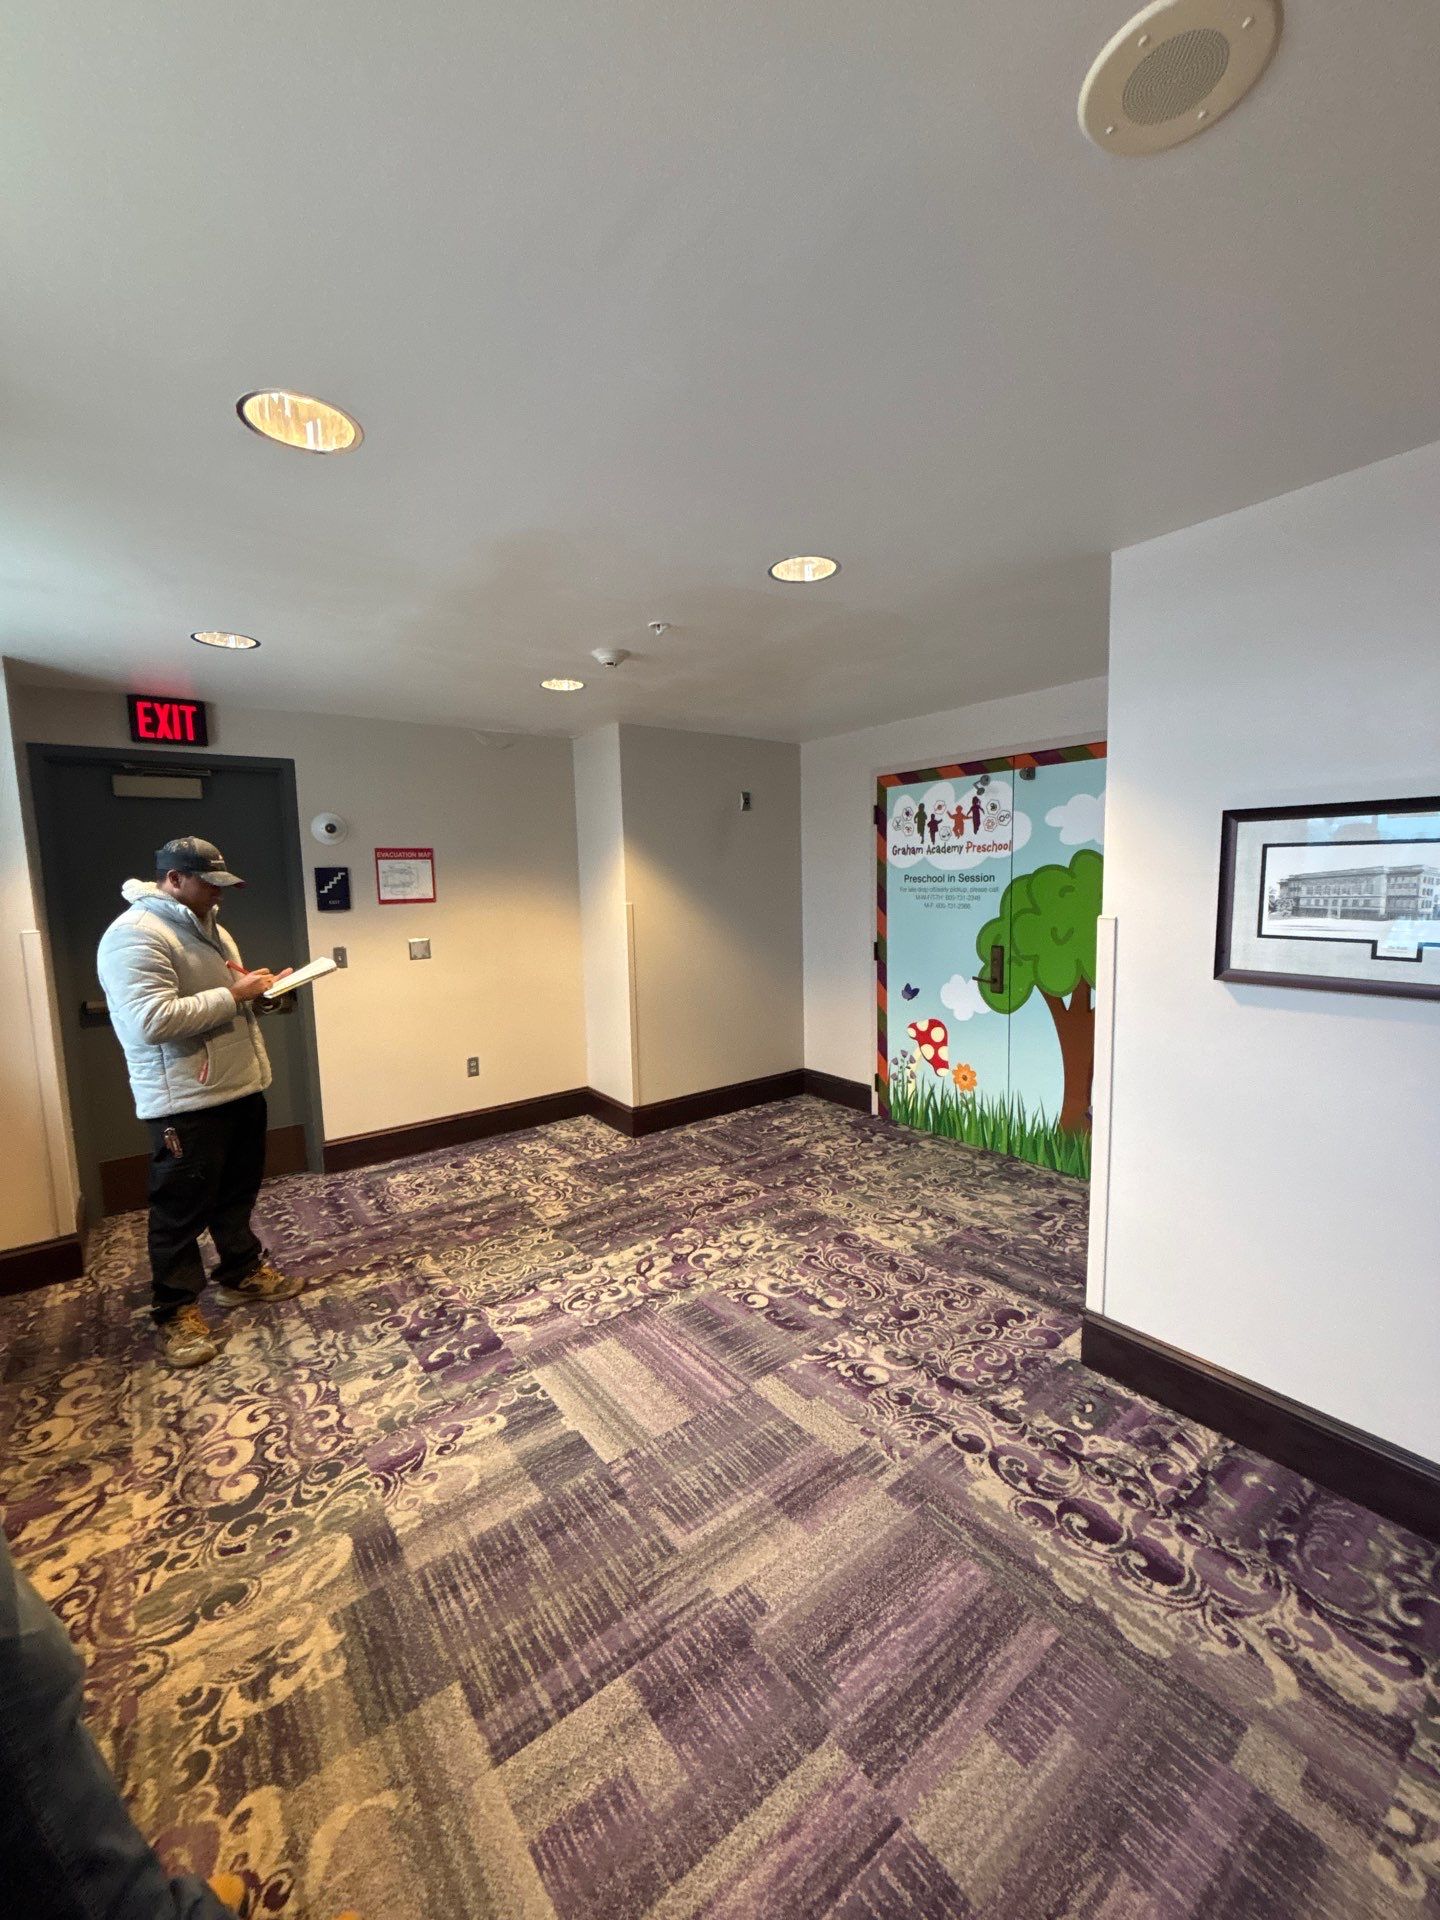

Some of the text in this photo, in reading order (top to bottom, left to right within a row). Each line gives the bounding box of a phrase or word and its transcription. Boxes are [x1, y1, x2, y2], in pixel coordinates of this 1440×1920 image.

[136, 701, 196, 741] EXIT
[892, 840, 1012, 856] Graham Academy Preschool
[376, 851, 432, 859] EVACUATION MAP
[904, 874, 945, 883] Preschool
[958, 873, 995, 883] Session
